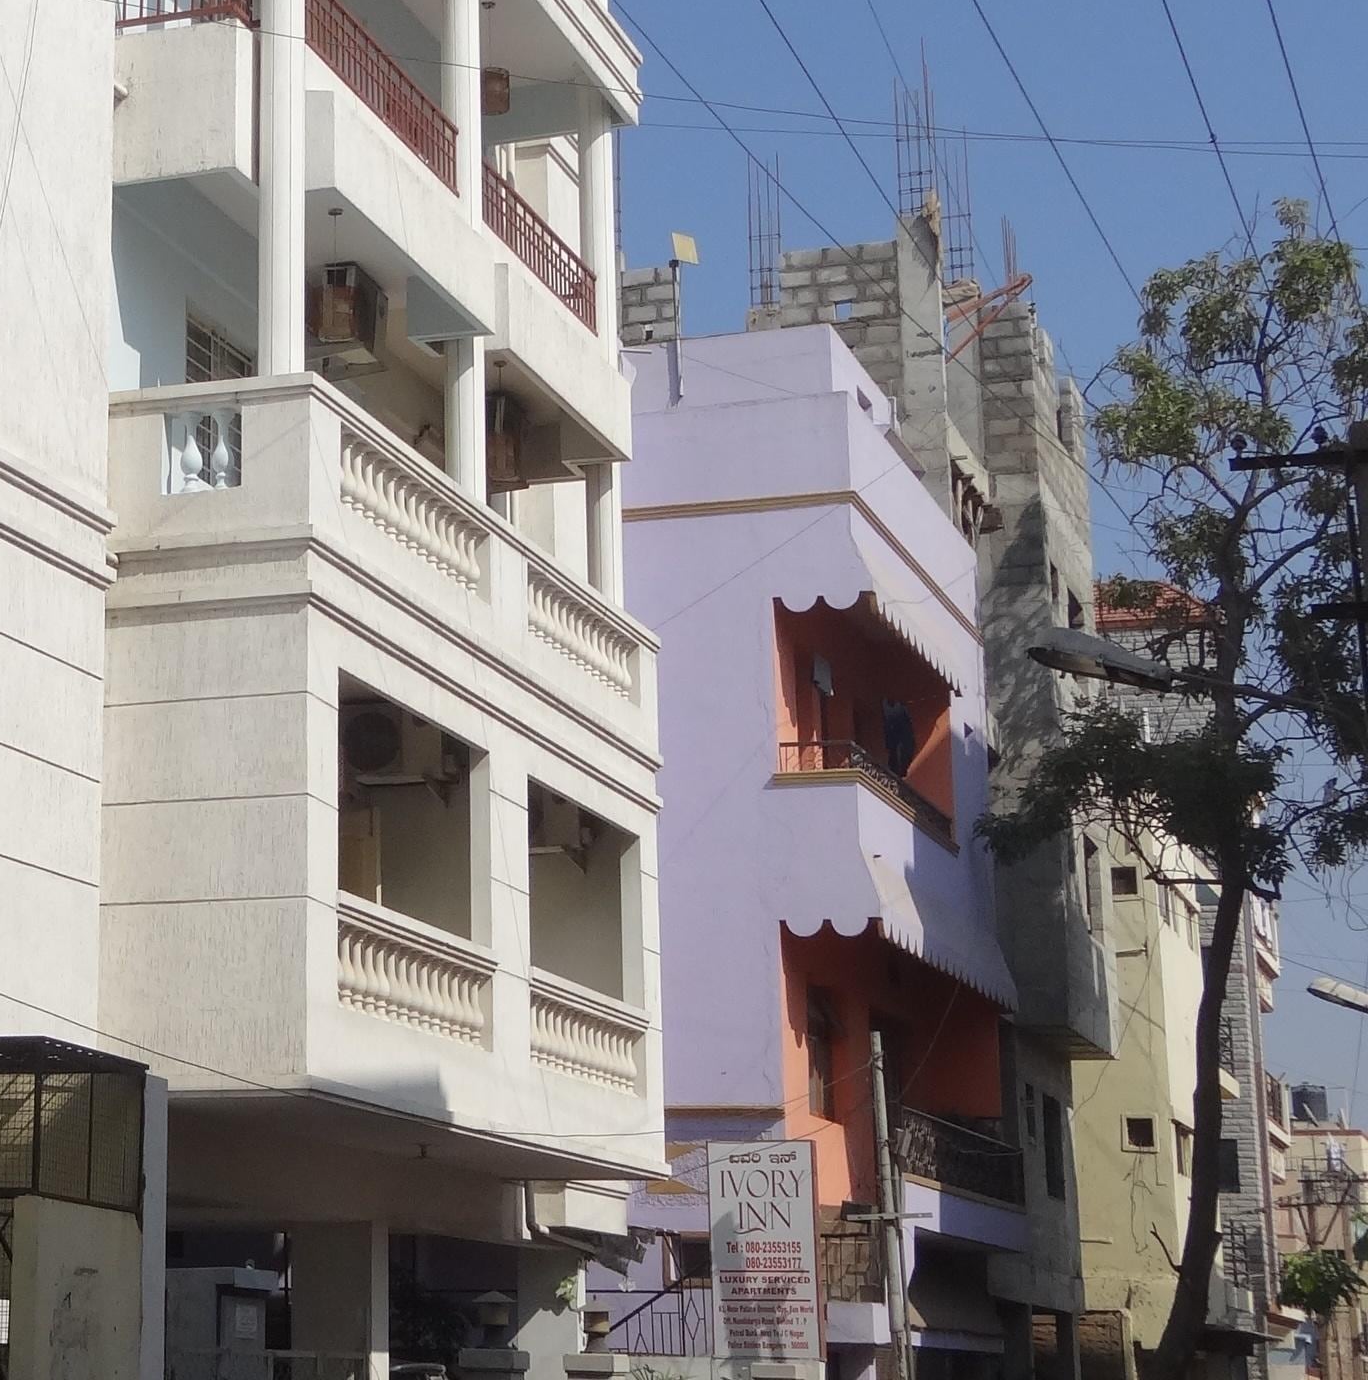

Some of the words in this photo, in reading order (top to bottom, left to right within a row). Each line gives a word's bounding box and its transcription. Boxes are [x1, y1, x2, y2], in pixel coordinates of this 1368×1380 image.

[720, 1169, 805, 1198] IVORY
[738, 1201, 791, 1230] INN
[726, 1241, 738, 1253] Tel
[745, 1241, 801, 1254] 080-23553155
[746, 1257, 802, 1269] 080-23553177
[719, 1276, 758, 1284] LUXURY
[762, 1276, 810, 1284] SERVICED
[731, 1287, 797, 1295] APARTMENTS
